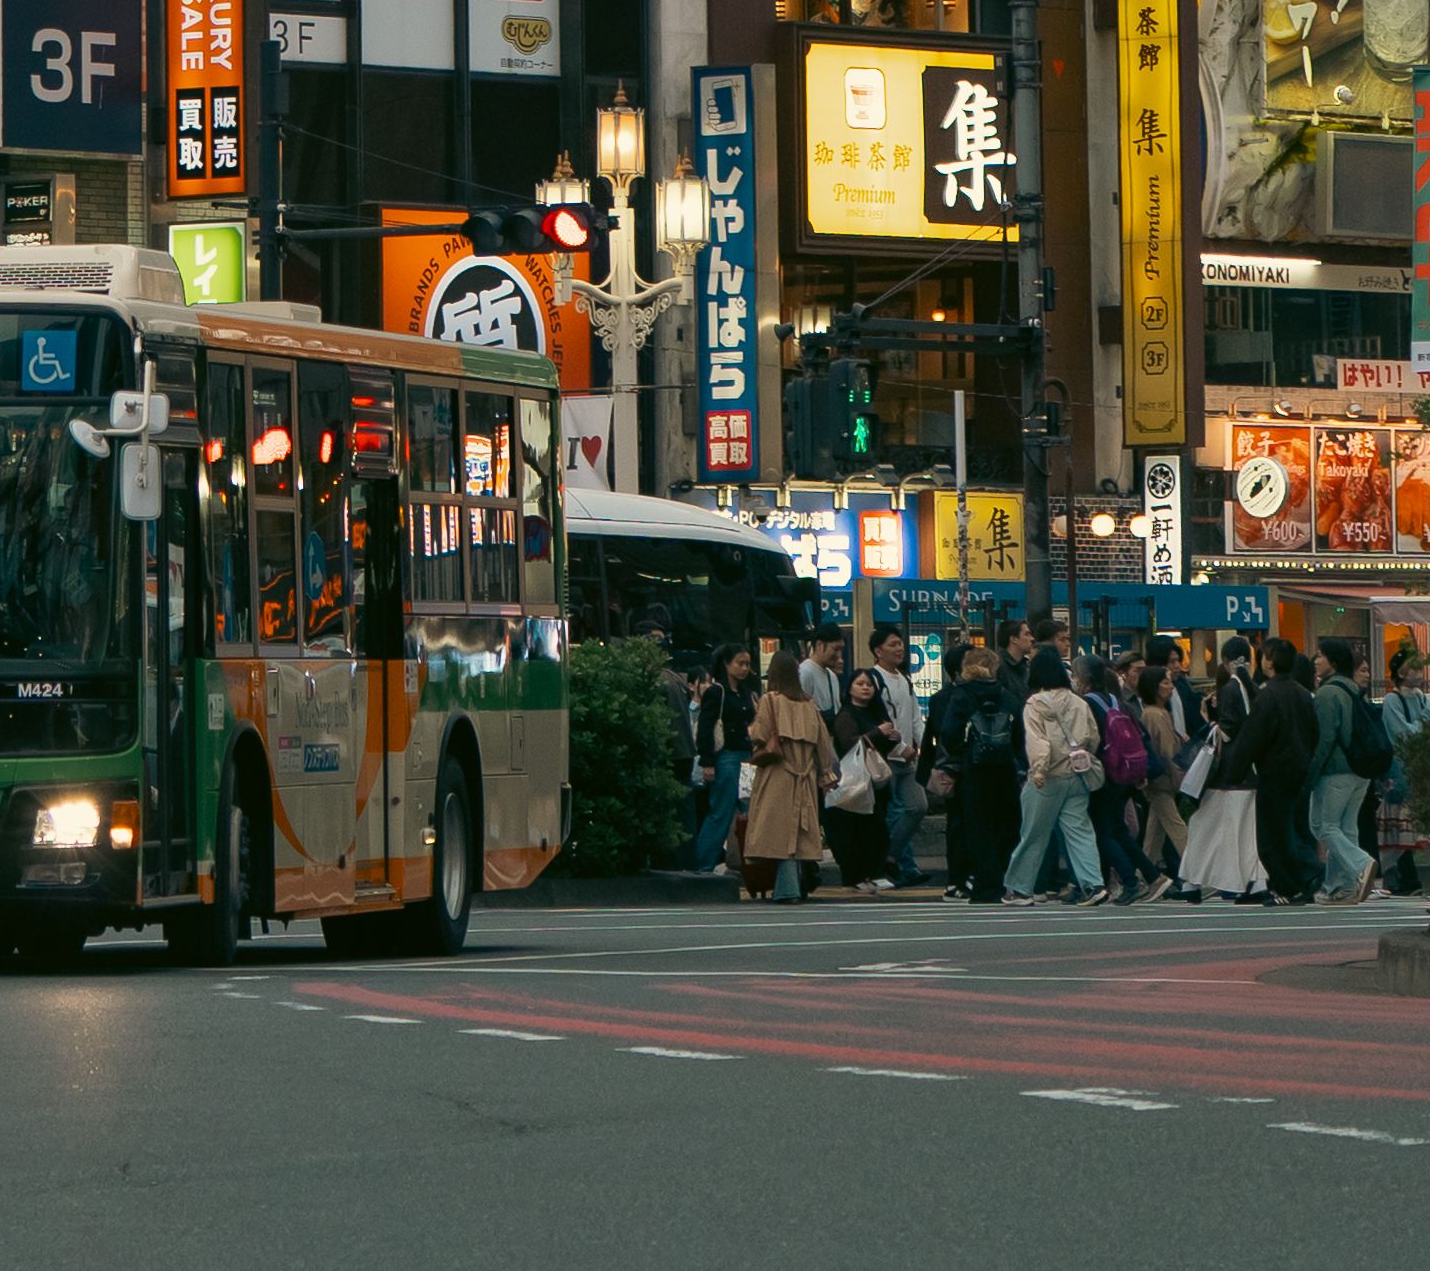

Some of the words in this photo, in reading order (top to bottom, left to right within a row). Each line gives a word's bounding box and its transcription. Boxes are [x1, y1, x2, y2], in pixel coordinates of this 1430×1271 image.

[30, 28, 117, 105] 3F
[178, 99, 204, 170] 買取
[213, 97, 237, 169] 販売
[935, 80, 1017, 211] 集
[814, 141, 912, 171] 珈琲茶館
[832, 183, 896, 206] Premium
[1144, 174, 1161, 281] Premium
[705, 150, 747, 398] じゃんぱら
[408, 258, 440, 332] BRANDS
[525, 254, 562, 337] WATCHES
[1145, 306, 1164, 321] 2F
[1146, 351, 1165, 366] 3F
[1237, 432, 1274, 456] 餃子
[1319, 432, 1376, 455] たこ焼き
[1319, 462, 1369, 479] Takoyaki
[984, 507, 1020, 572] 集
[1227, 595, 1239, 622] P
[18, 684, 62, 697] M424
